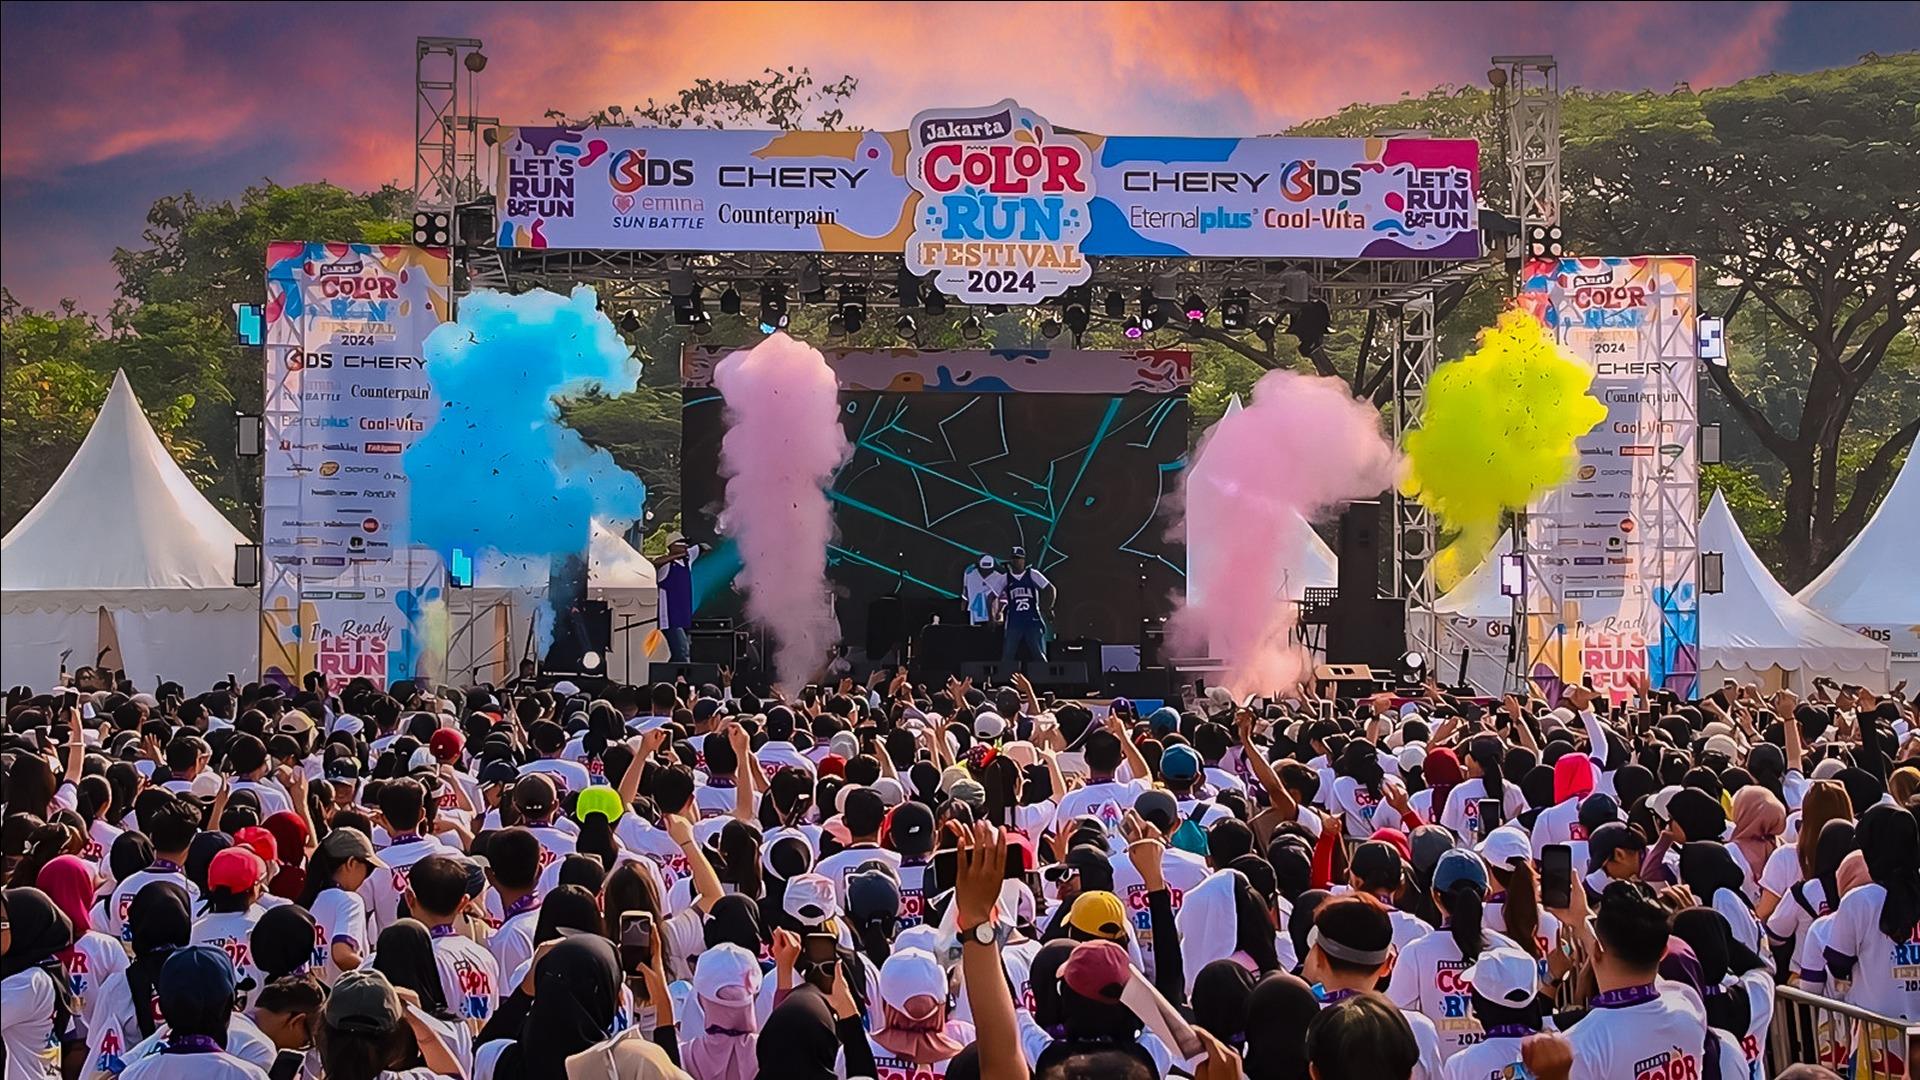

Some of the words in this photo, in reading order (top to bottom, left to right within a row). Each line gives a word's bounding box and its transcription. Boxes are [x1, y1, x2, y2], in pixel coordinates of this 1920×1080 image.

[926, 119, 1005, 141] Jakarta
[509, 156, 575, 176] LET'S
[718, 165, 870, 189] CHERY
[924, 144, 1086, 193] COLOR
[509, 176, 575, 199] RUN
[1123, 171, 1271, 193] CHERY
[1407, 168, 1469, 190] LET'S
[506, 199, 575, 218] &FUN
[642, 197, 704, 212] emina
[1406, 189, 1469, 211] RUN
[612, 216, 645, 229] SUN
[648, 216, 705, 230] BATTLE
[718, 203, 838, 229] Counterpain
[942, 195, 1064, 241] RUN
[1264, 206, 1366, 230] Cool-Vita
[1404, 211, 1469, 230] &FUN
[923, 243, 1082, 268] FESTIVAL
[321, 276, 399, 299] COLOR
[967, 270, 1036, 293] 2024
[1575, 287, 1647, 309] COLOR
[341, 334, 375, 346] 2024
[1594, 342, 1626, 354] 2024
[343, 356, 427, 370] CHERY
[1597, 362, 1678, 375] CHERY
[351, 383, 430, 401] Counterpain
[359, 416, 424, 432] Cool-Vita
[1015, 599, 1030, 611] 25
[342, 616, 394, 641] Ready
[321, 654, 386, 675] RUN
[1584, 650, 1645, 670] RUN
